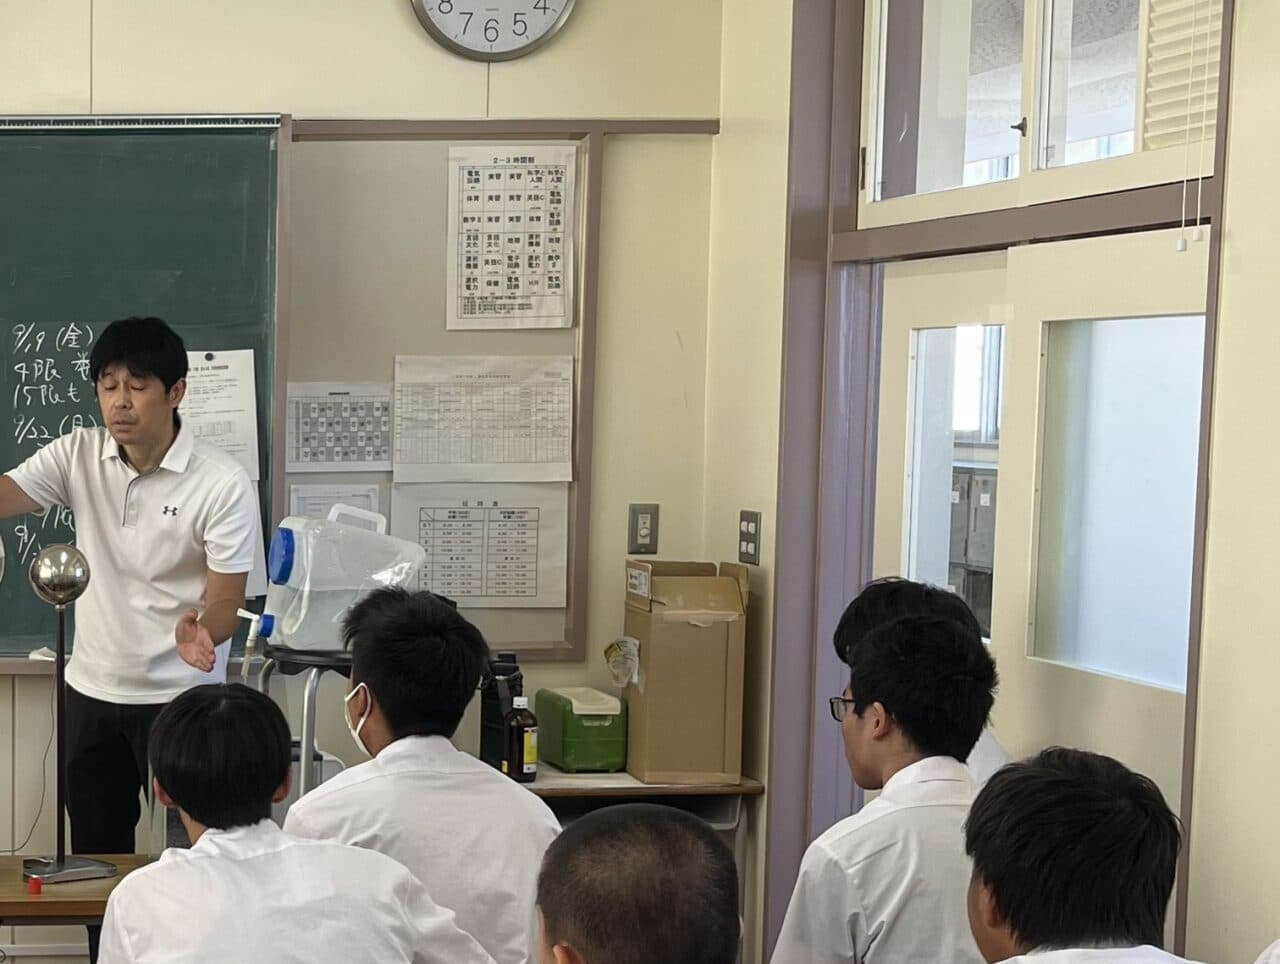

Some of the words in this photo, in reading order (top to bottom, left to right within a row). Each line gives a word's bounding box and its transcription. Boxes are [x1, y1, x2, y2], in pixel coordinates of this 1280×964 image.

[459, 13, 473, 35] 7
[484, 19, 499, 42] 6
[512, 13, 527, 36] 5
